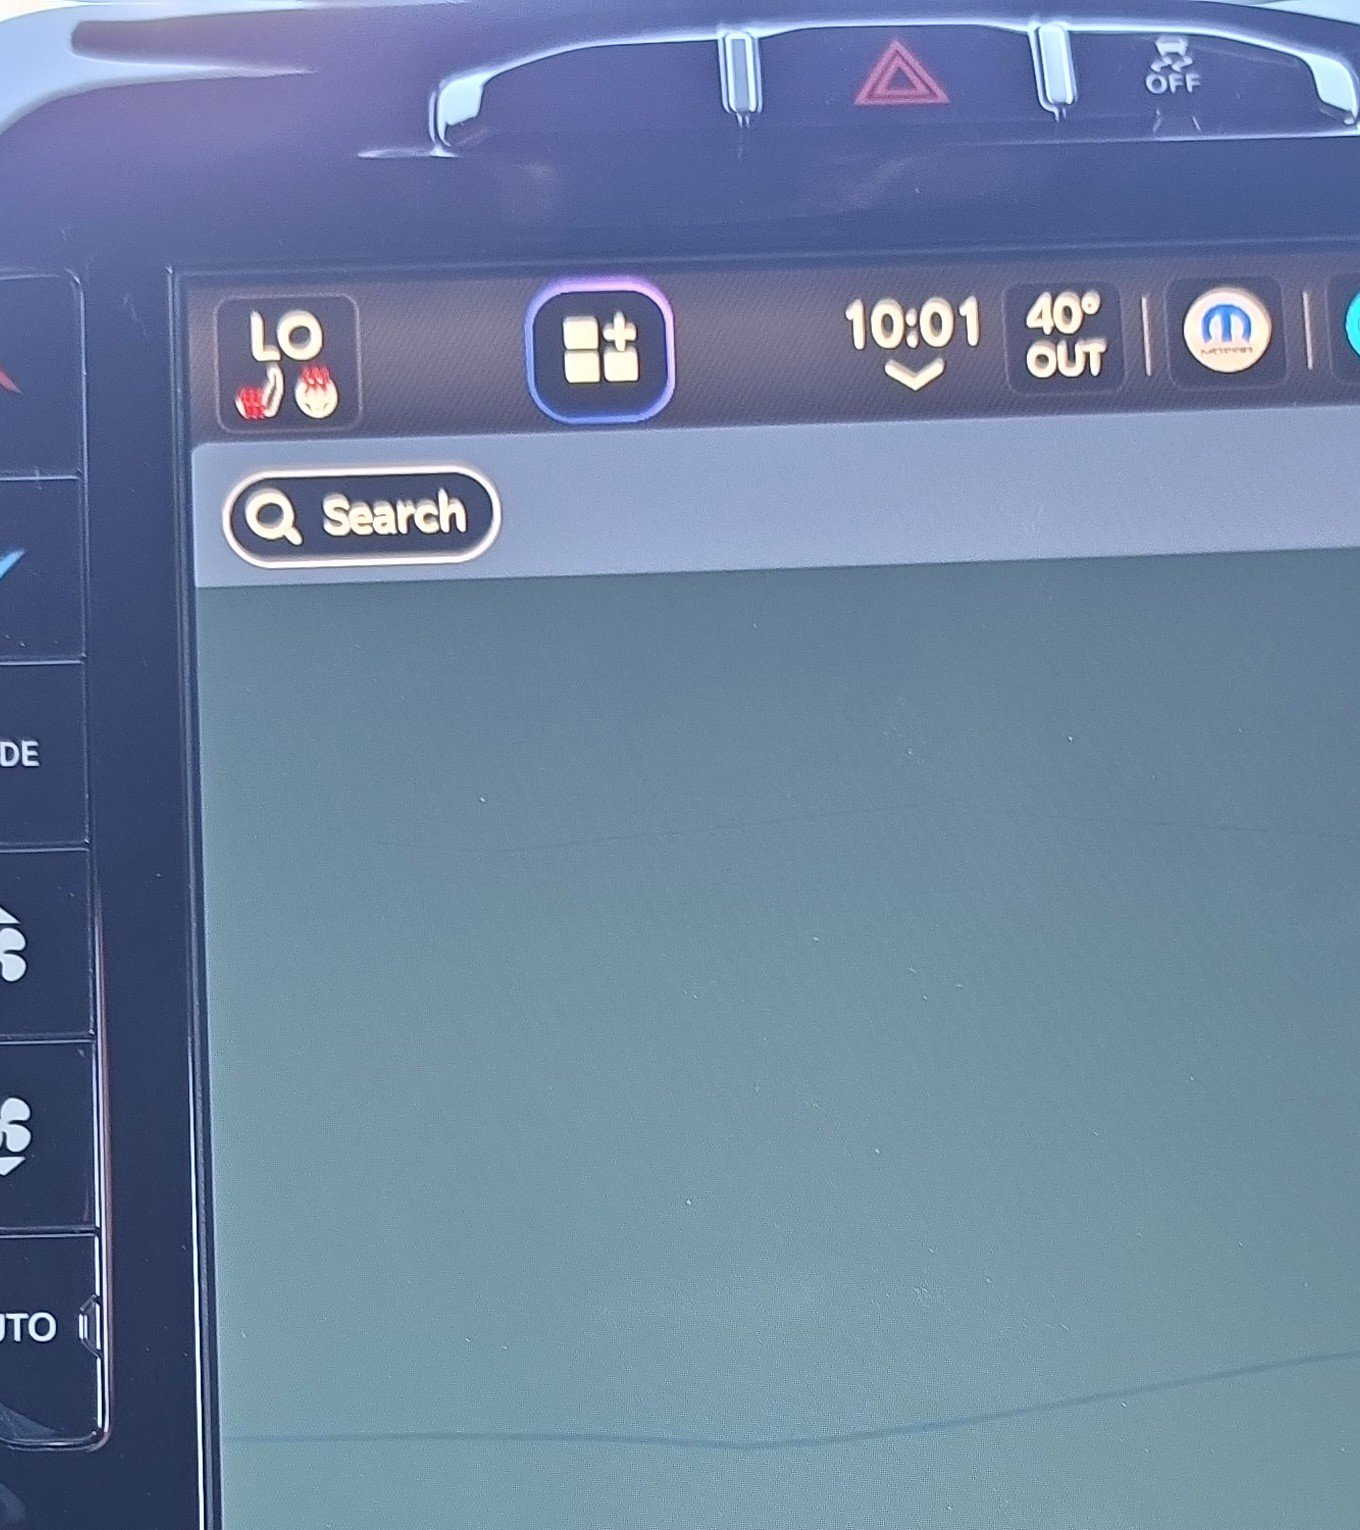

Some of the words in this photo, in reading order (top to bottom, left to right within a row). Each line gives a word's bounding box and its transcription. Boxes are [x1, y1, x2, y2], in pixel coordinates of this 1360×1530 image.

[1145, 72, 1201, 95] OFF
[844, 295, 981, 350] 10:01
[1026, 290, 1099, 335] 40°
[249, 310, 324, 363] LO
[1026, 340, 1106, 379] OUT
[322, 488, 467, 538] Search
